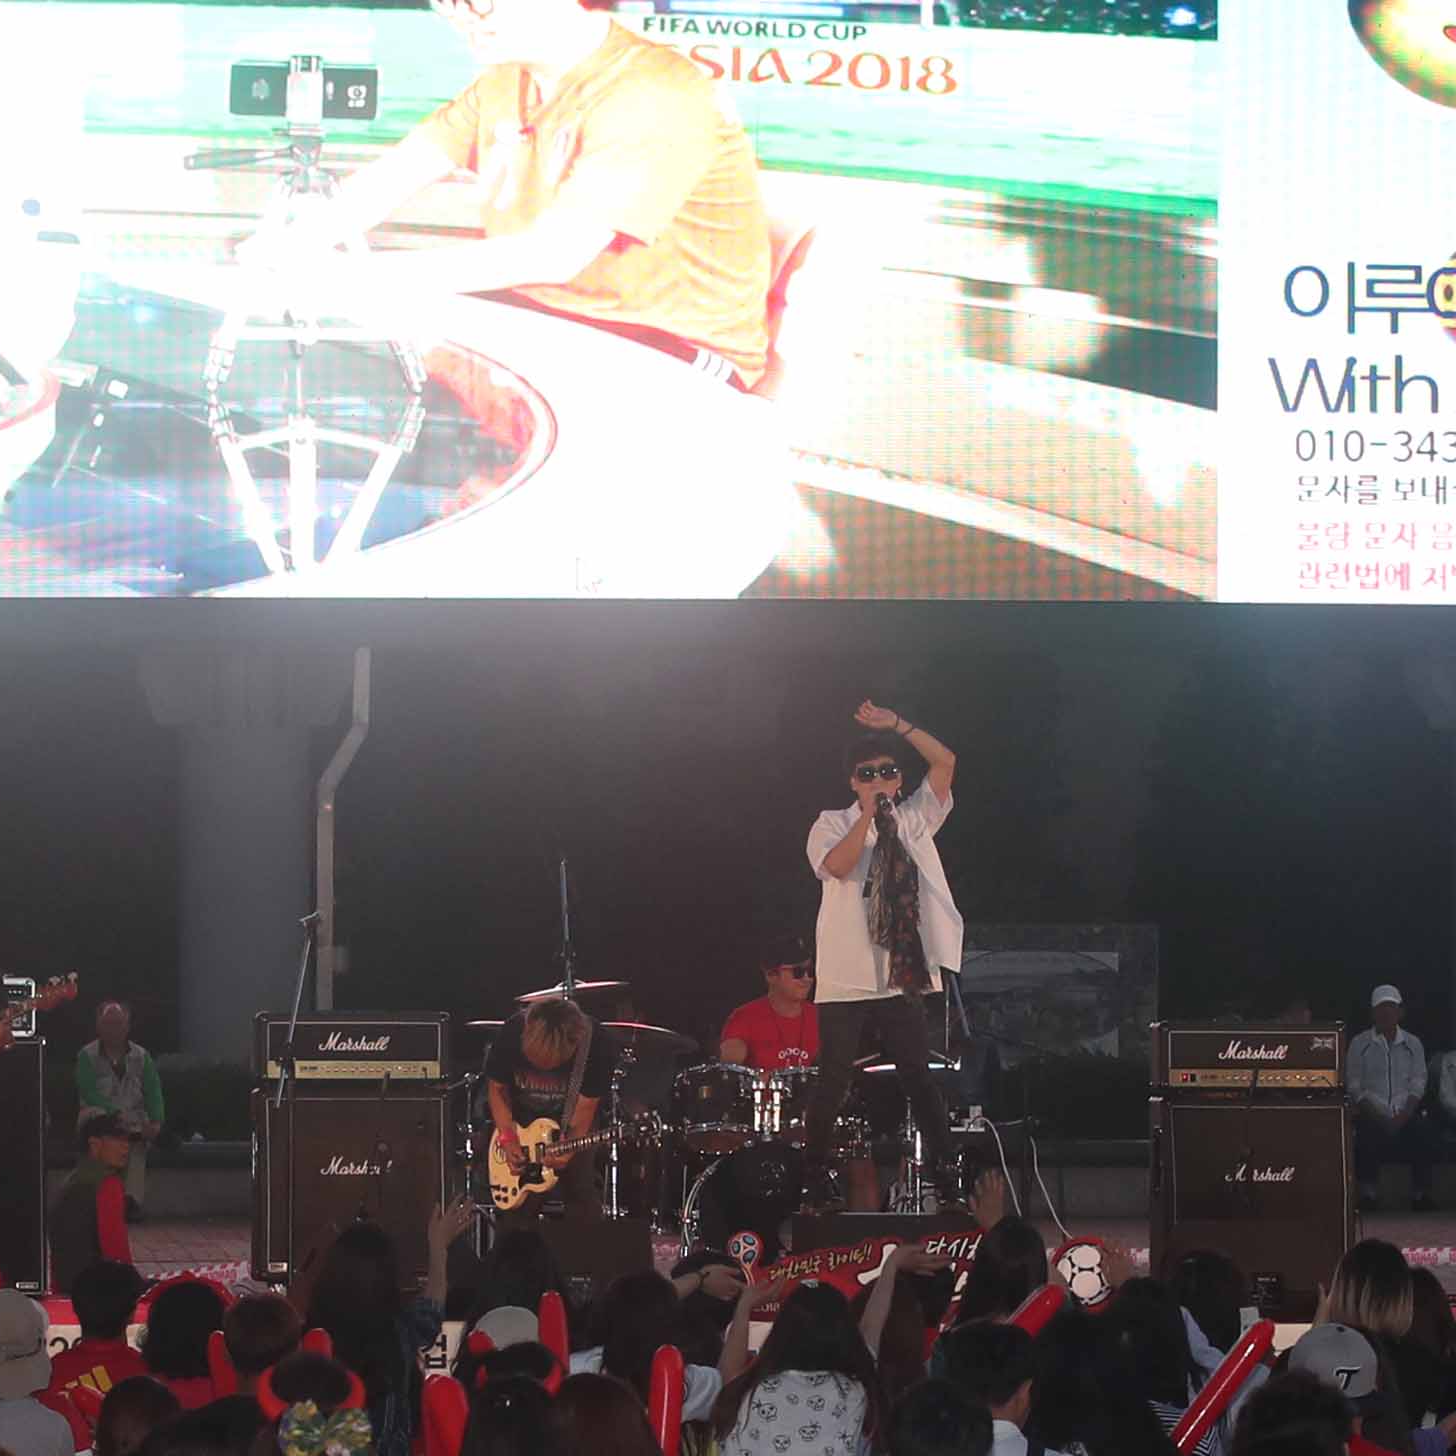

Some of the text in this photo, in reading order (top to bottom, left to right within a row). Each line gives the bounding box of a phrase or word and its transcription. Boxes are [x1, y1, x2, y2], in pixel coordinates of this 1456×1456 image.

[642, 14, 868, 41] FIFA WORLD CUP
[804, 49, 958, 95] 2018
[1267, 354, 1440, 415] With
[318, 1031, 391, 1052] Marshall
[1218, 1039, 1289, 1060] Marshall
[1224, 1163, 1296, 1182] Mrshall
